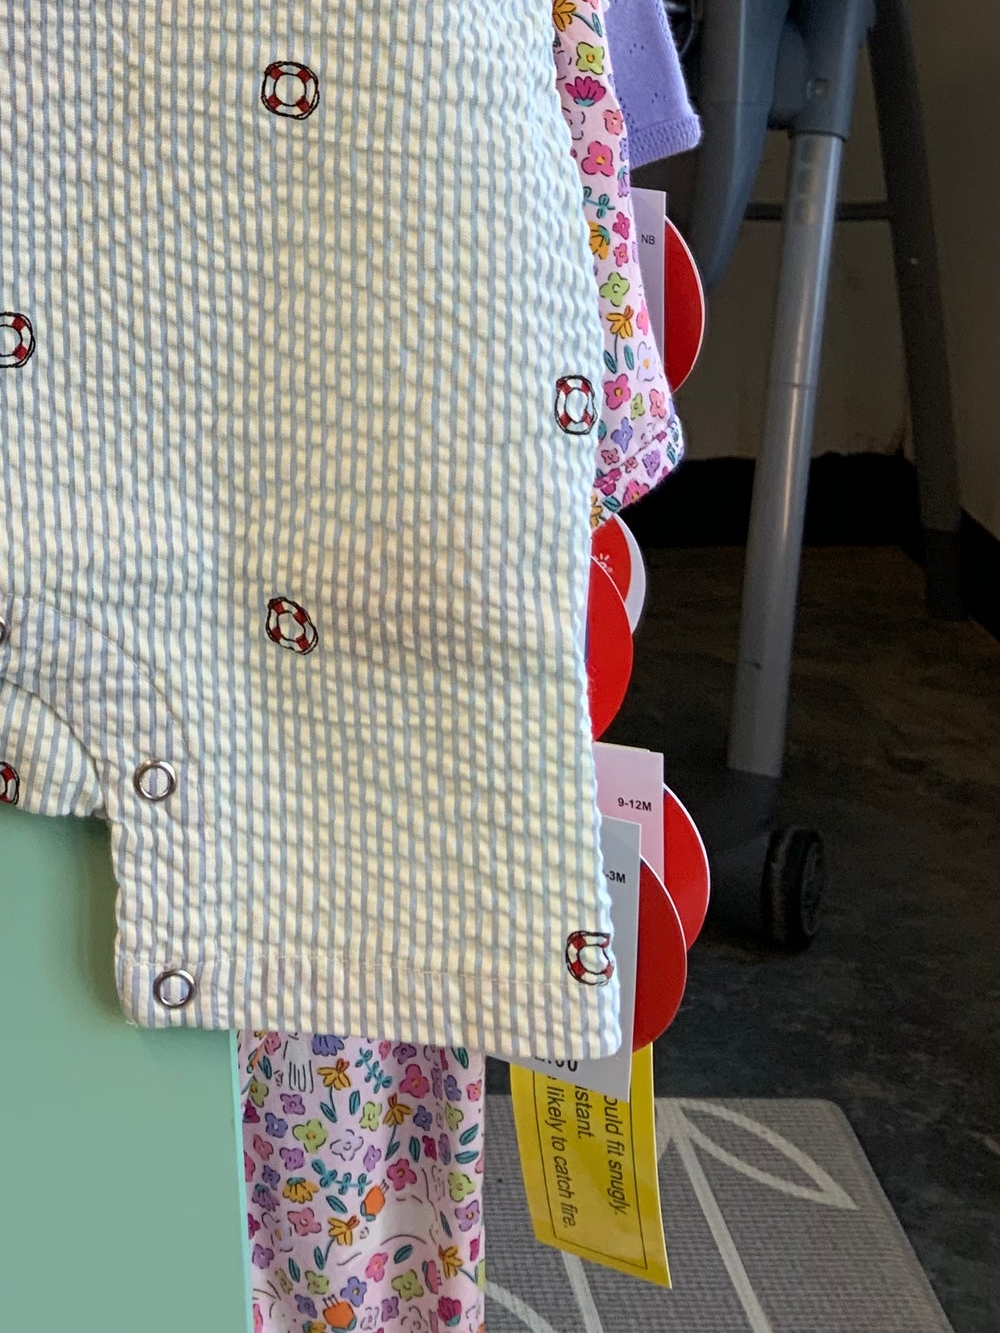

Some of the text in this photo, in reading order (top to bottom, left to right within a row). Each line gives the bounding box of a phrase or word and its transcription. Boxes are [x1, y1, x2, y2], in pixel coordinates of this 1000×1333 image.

[641, 233, 655, 245] NB
[617, 797, 652, 812] 9-12M
[606, 870, 626, 884] -3M
[545, 1086, 568, 1134] likely
[575, 1084, 596, 1141] istant.
[552, 1137, 568, 1152] to
[603, 1094, 632, 1216] ould fit snugly.
[553, 1156, 576, 1206] catch
[560, 1206, 579, 1230] fire.
